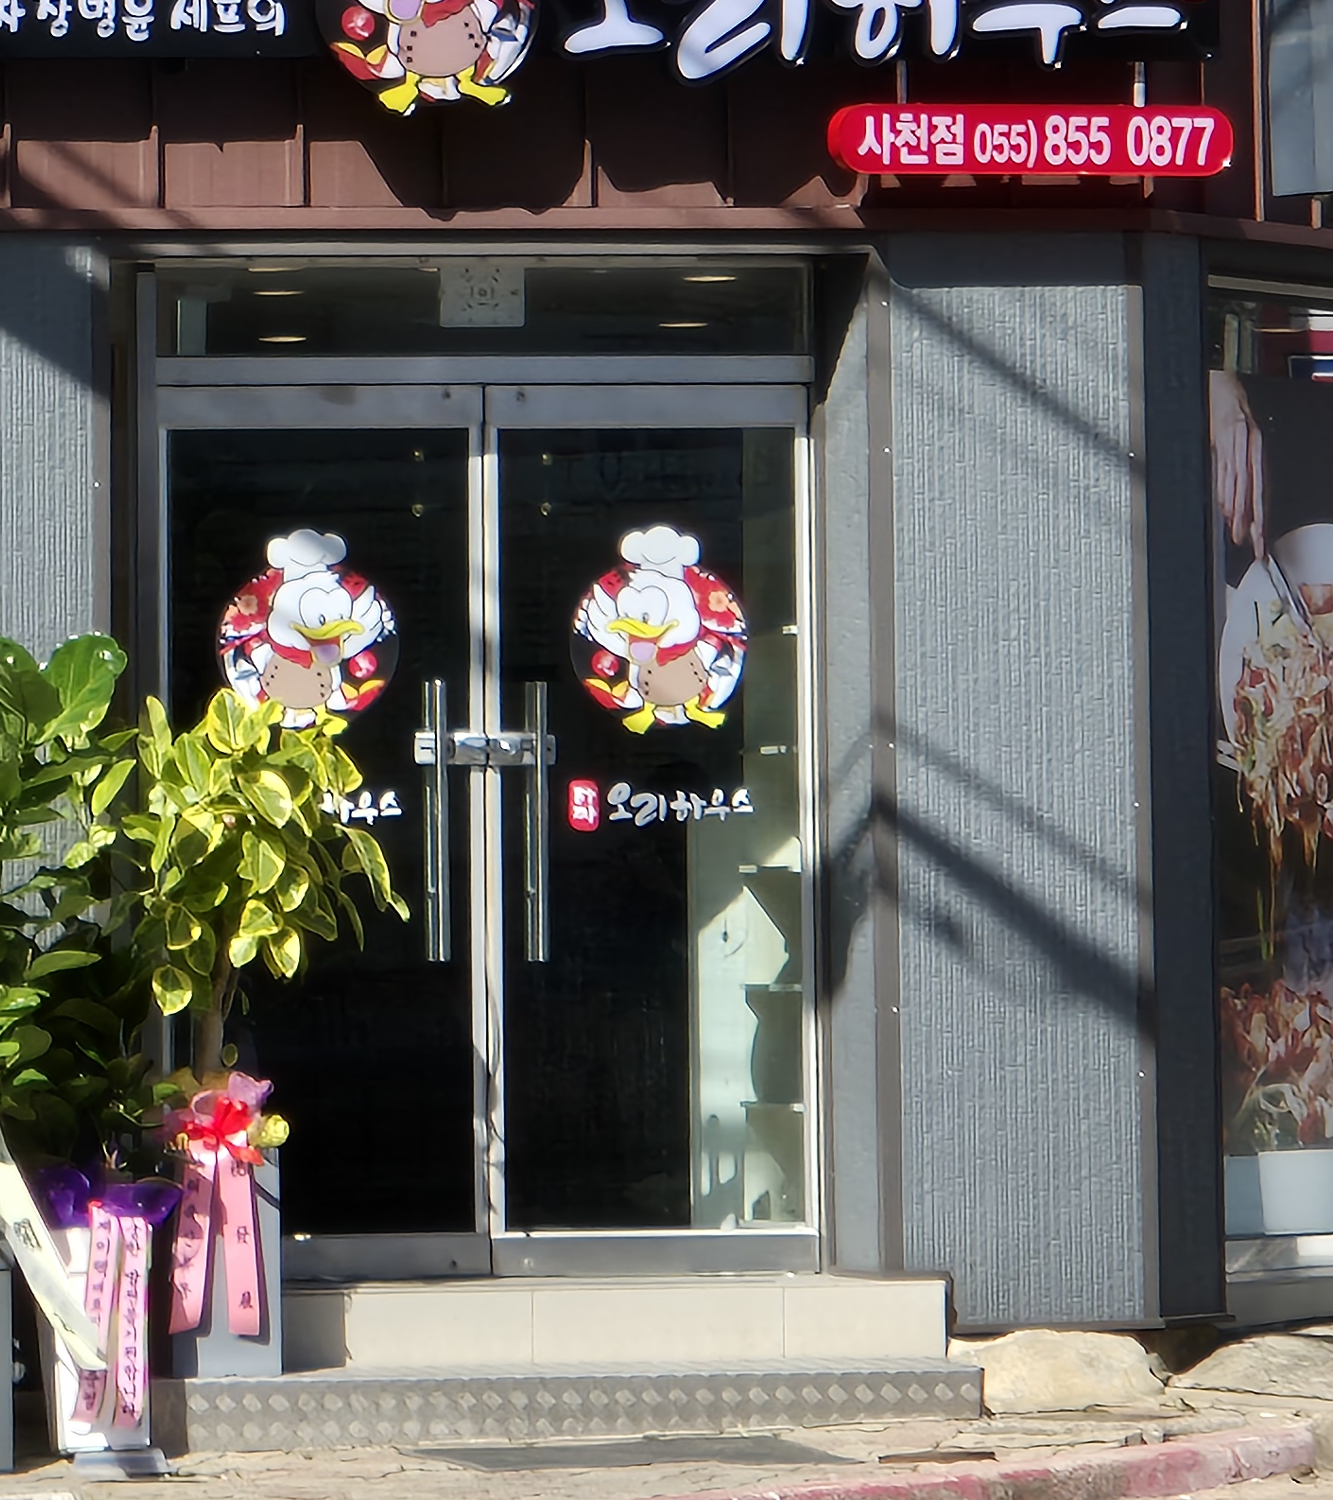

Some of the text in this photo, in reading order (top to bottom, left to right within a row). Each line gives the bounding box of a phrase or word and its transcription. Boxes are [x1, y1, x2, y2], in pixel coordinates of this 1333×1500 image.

[857, 113, 1215, 169] 사천점 055) 855 0877
[318, 790, 403, 826] 하우스
[606, 781, 755, 828] 오리하우스
